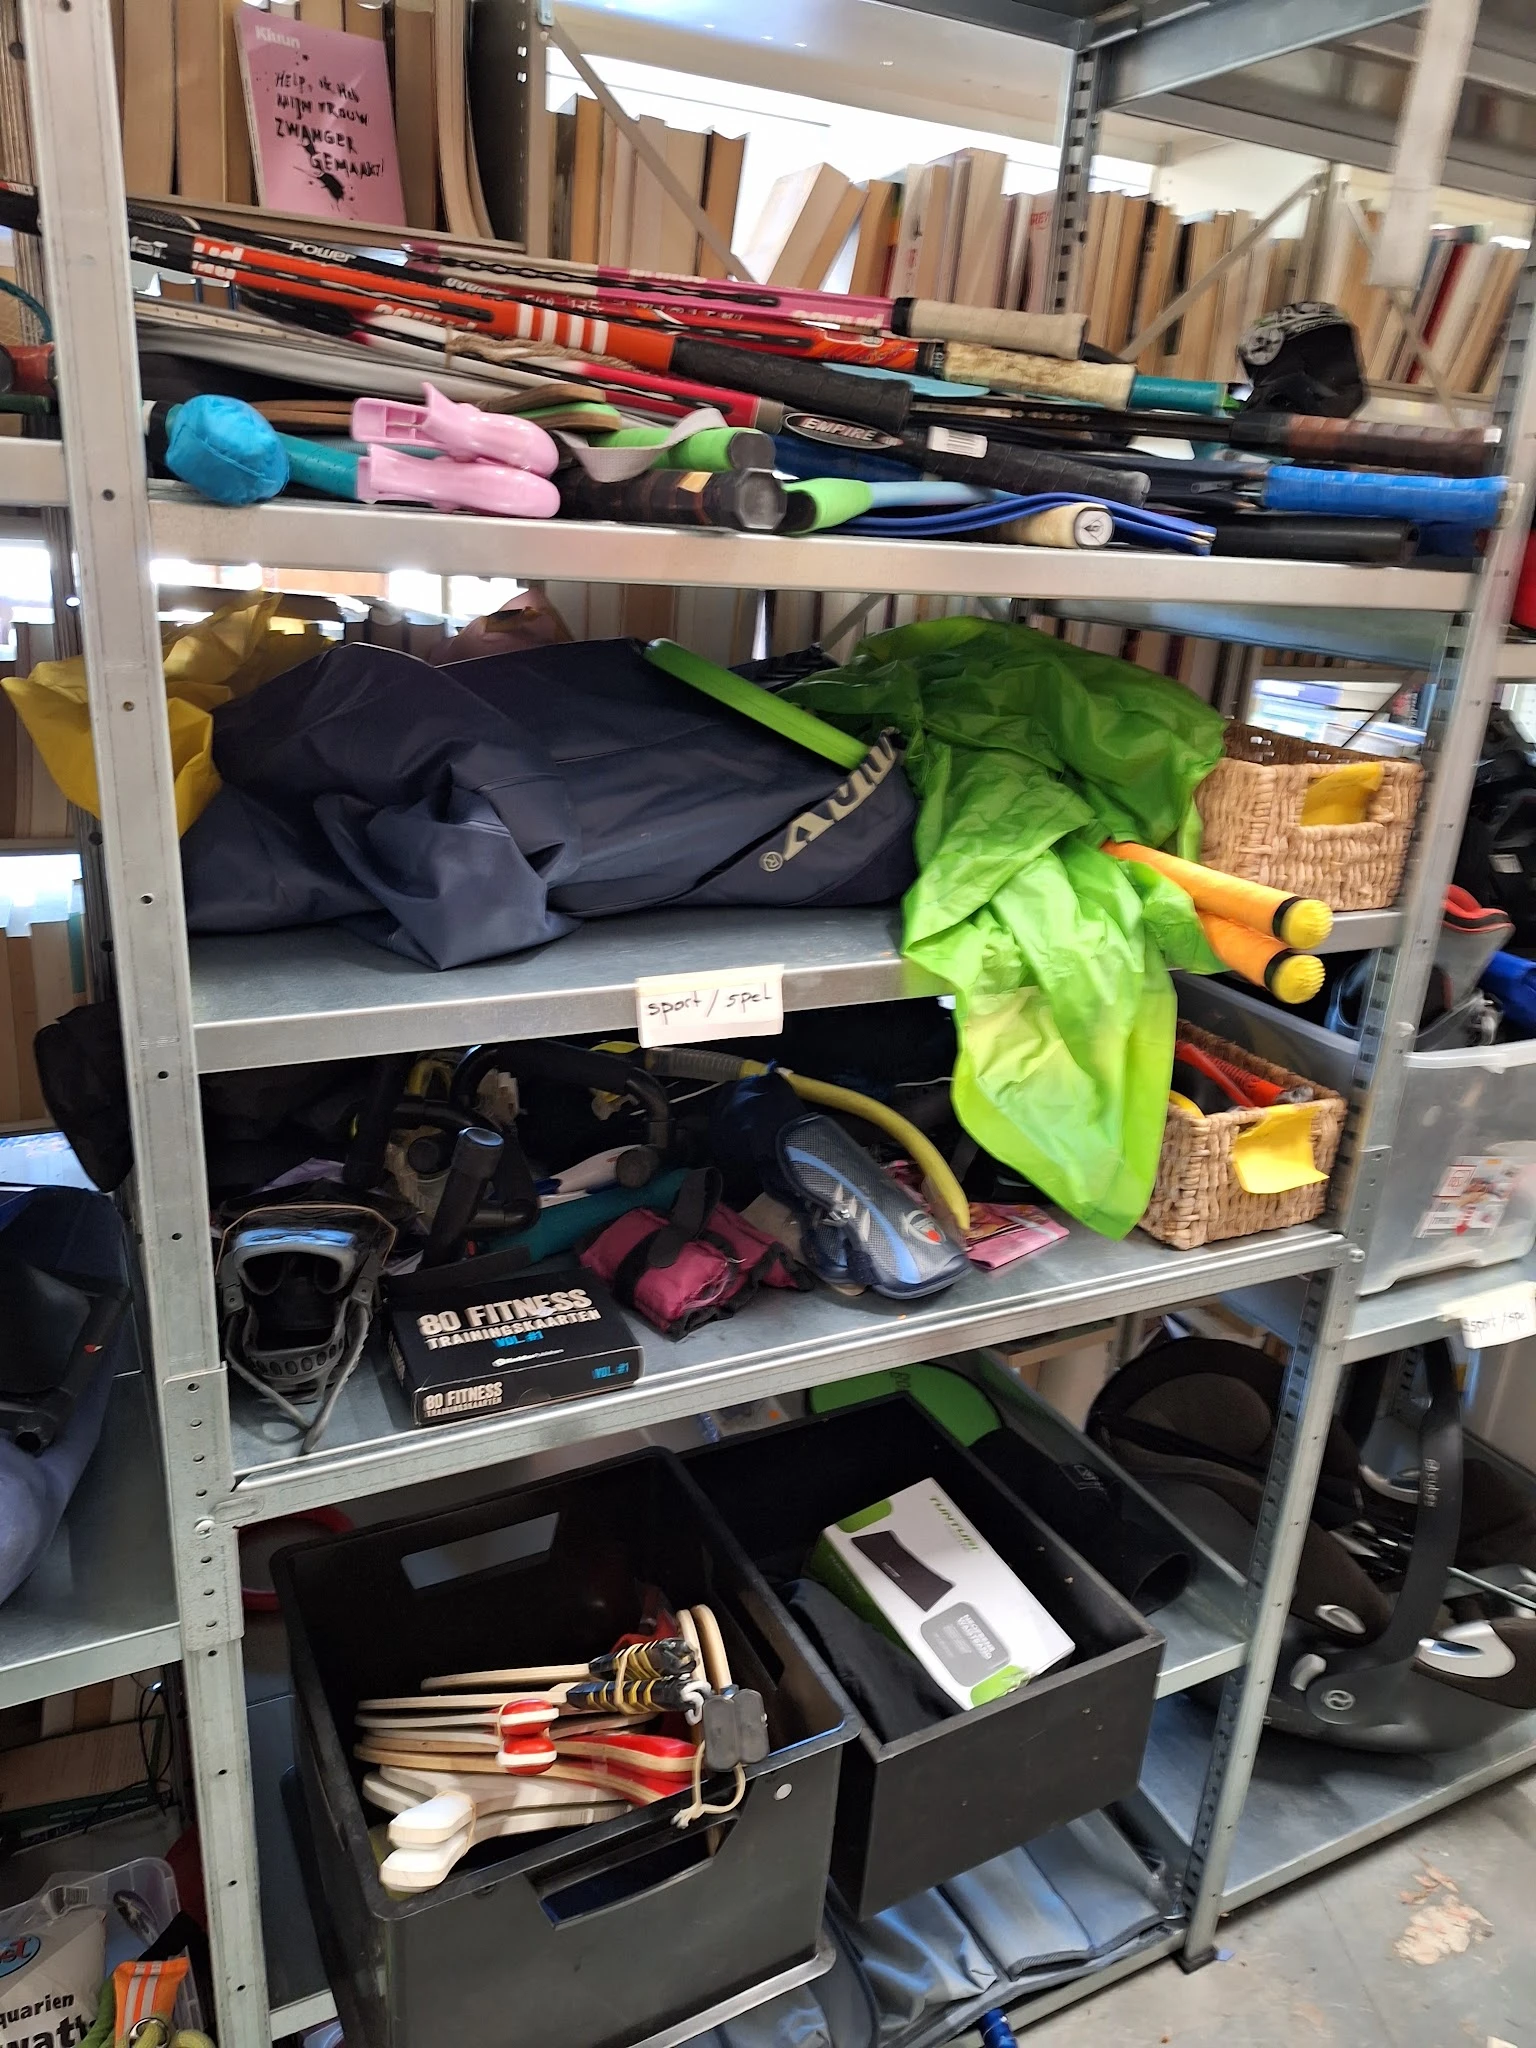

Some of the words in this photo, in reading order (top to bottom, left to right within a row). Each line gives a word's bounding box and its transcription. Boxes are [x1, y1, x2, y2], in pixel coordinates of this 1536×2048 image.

[800, 417, 878, 442] EMPIRE
[648, 990, 701, 1025] sport
[726, 982, 772, 1013] spel
[416, 1311, 462, 1337] 80
[464, 1288, 593, 1328] FITNESS
[424, 1309, 602, 1351] TRAININGSKAARTEN
[424, 1392, 444, 1411] 80
[446, 1381, 503, 1407] FITNESS
[929, 1496, 981, 1553] TUNTURI
